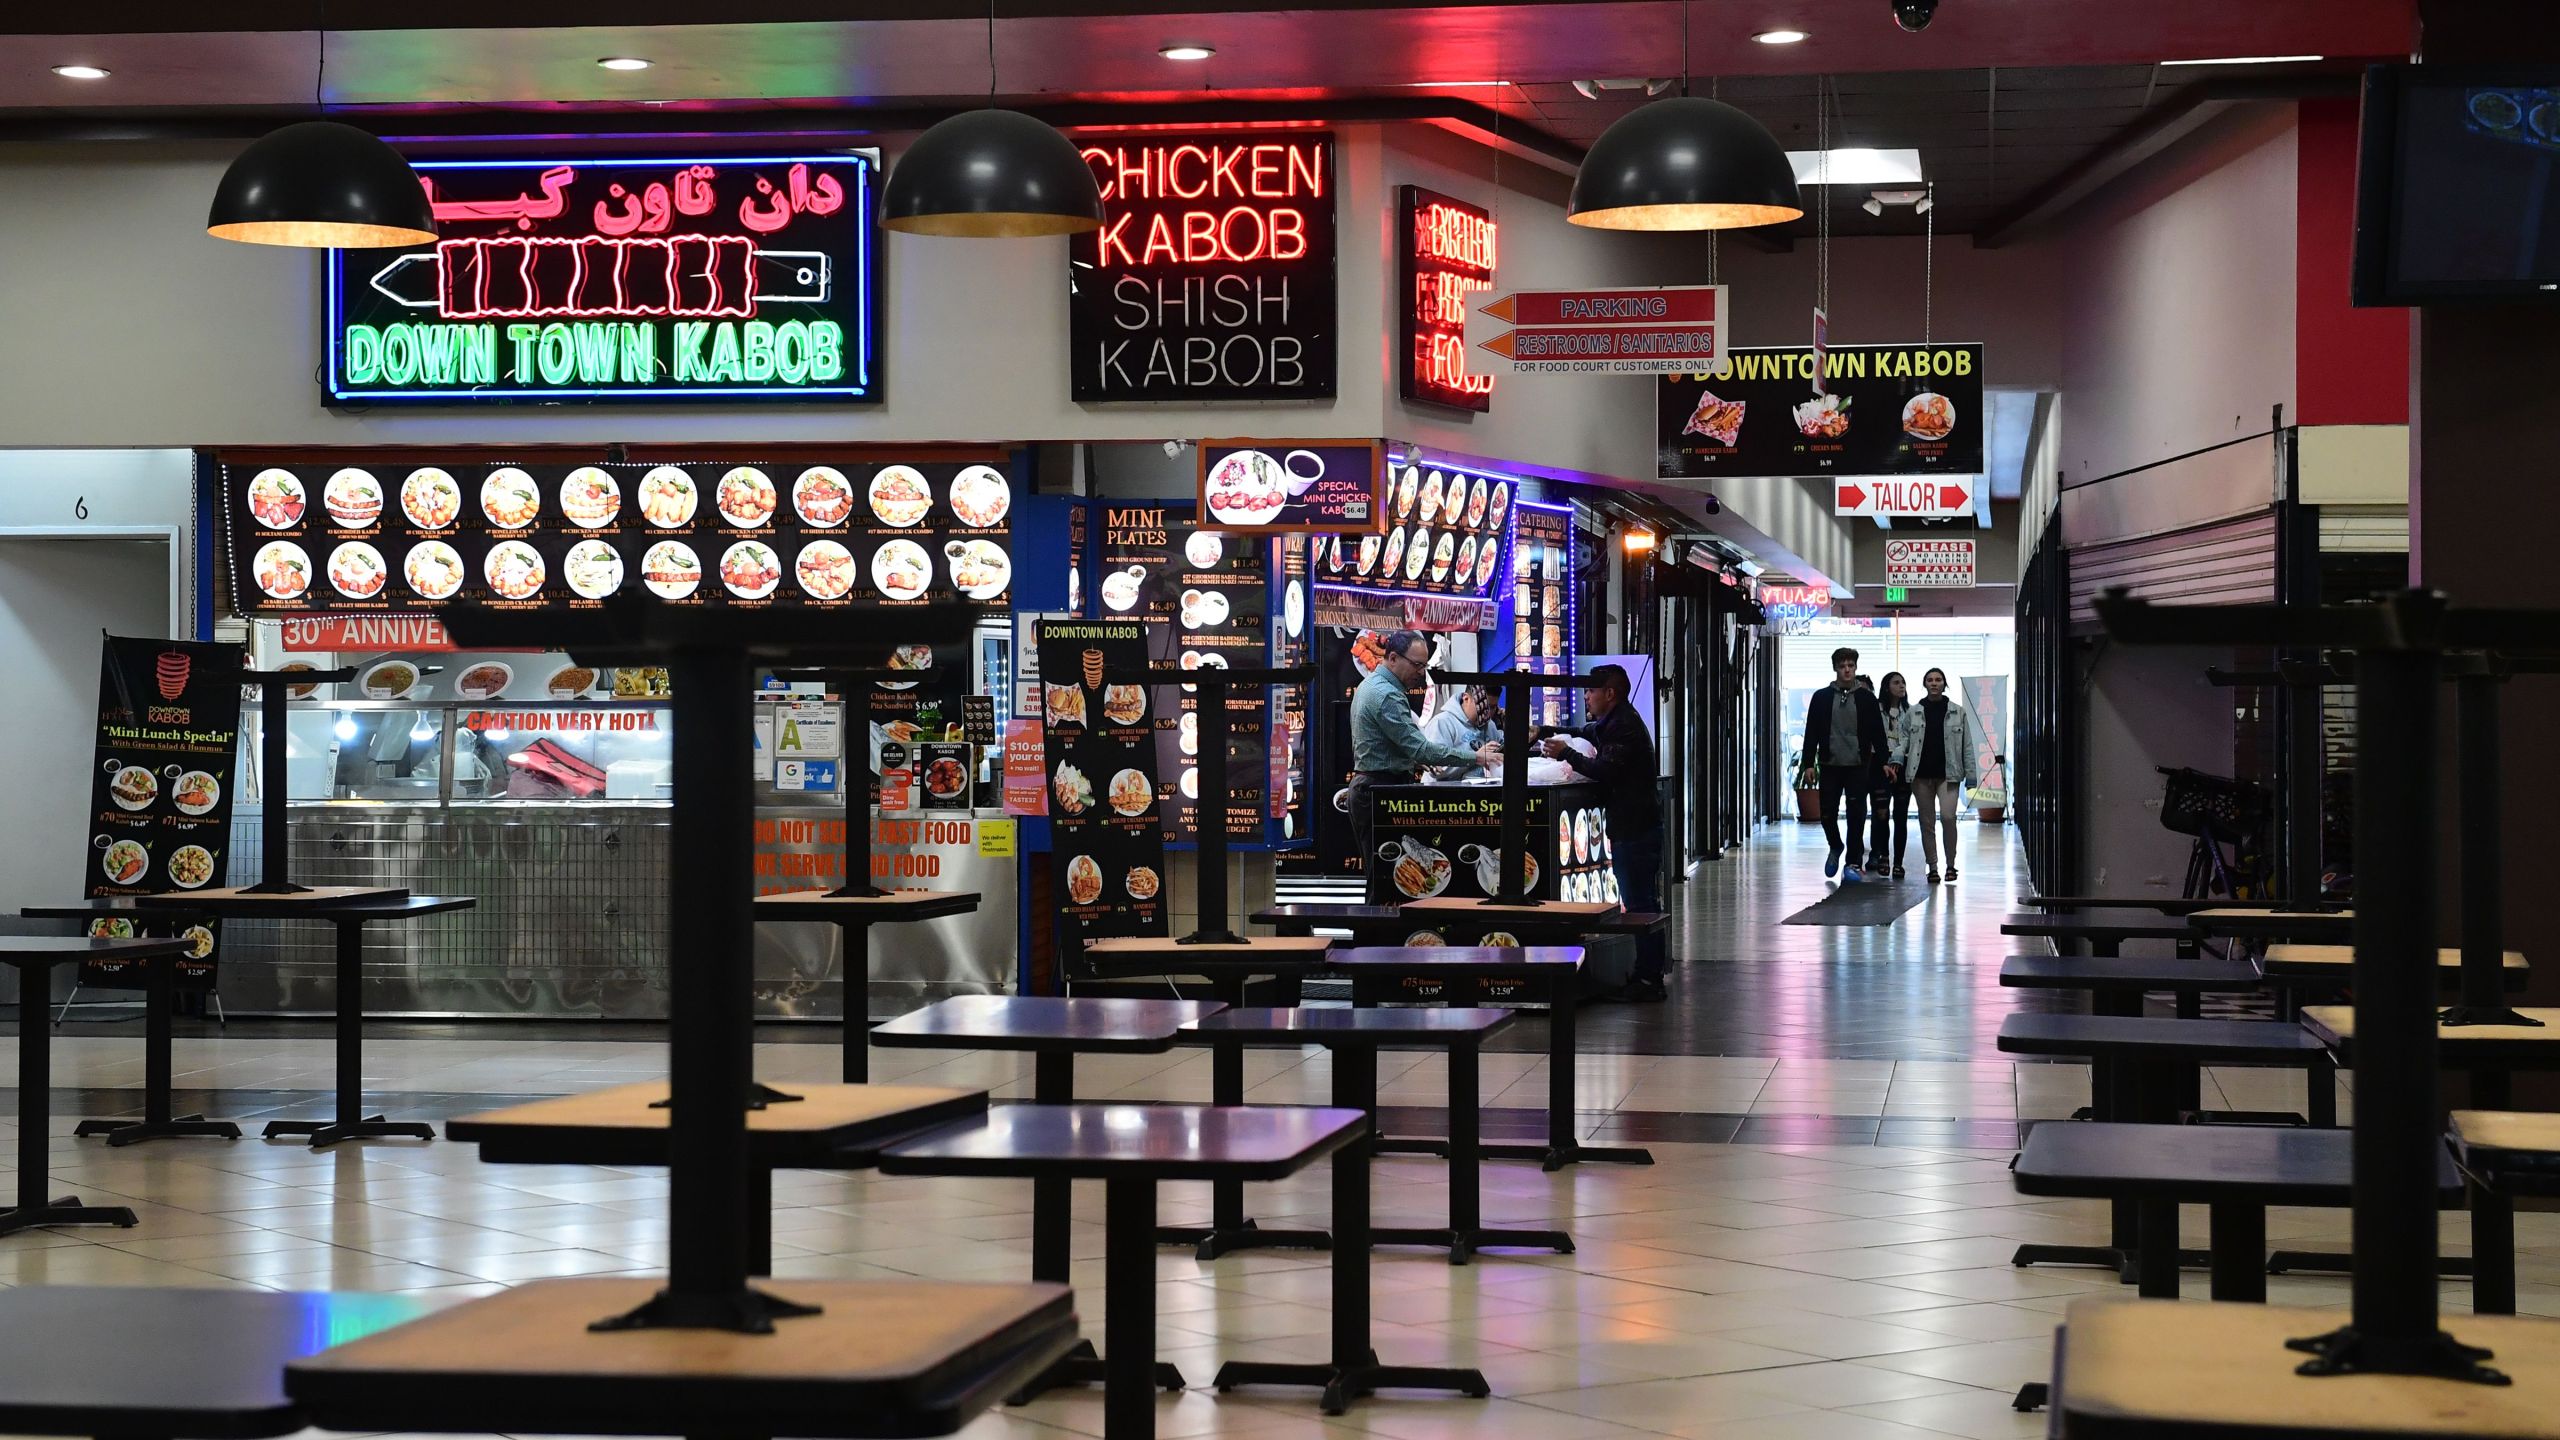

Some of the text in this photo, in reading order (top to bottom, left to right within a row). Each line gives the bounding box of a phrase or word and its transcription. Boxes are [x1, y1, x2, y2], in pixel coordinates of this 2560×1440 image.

[1080, 143, 1324, 200] CHICKEN
[739, 163, 846, 233] دان
[1098, 205, 1307, 267] KABOB
[1113, 274, 1291, 331] SHISH
[1560, 297, 1667, 319] PARKING
[1516, 333, 1611, 355] RESTROOMS
[1621, 332, 1712, 354] SANITARIOS
[346, 320, 845, 385] DOWN TOWN KABOB
[1100, 334, 1305, 390] KABOB
[1514, 360, 1714, 372] FOR FOOD COURT CUSTOMERS ONLY
[1875, 350, 1973, 378] KABOB
[1317, 481, 1359, 491] SPECIAL
[1303, 492, 1372, 503] MINI CHICKEN
[1871, 482, 1936, 512] TAILOR
[75, 495, 88, 520] 6
[1346, 506, 1366, 514] $6.49
[1107, 508, 1166, 529] MINI
[1519, 512, 1562, 530] CATERING
[1106, 530, 1167, 545] PLATES
[1912, 543, 1968, 552] PLEASE
[1886, 587, 1905, 602] EXIT
[1238, 617, 1259, 627] 7.99
[284, 617, 335, 646] 30TH
[1044, 625, 1139, 639] DOWNTOWN KABOB
[1149, 660, 1176, 670] $6.99
[148, 706, 191, 714] DOWNTOWN
[883, 702, 913, 710] Sandwich
[915, 701, 921, 711] $
[147, 713, 191, 725] KABOB
[466, 711, 655, 731] CAUTION VERY HOT!
[142, 727, 181, 741] Lunch
[779, 718, 802, 751] A
[1238, 722, 1260, 733] 6.99
[132, 741, 156, 749] Green
[157, 742, 178, 750] Salad
[1009, 742, 1029, 751] $10
[1009, 753, 1033, 763] your
[1237, 788, 1258, 800] 3.67
[1182, 807, 1195, 815] WE
[1428, 799, 1477, 813] Lunch
[1178, 816, 1194, 824] ANY
[1233, 817, 1260, 825] EVENT
[1392, 817, 1484, 825] With Green Salad &
[779, 820, 815, 845] NOT
[877, 821, 922, 845] FAST
[924, 821, 972, 845] FOOD
[779, 853, 836, 877] SERVE
[893, 854, 940, 878] FOOD
[1343, 856, 1363, 870] #71
